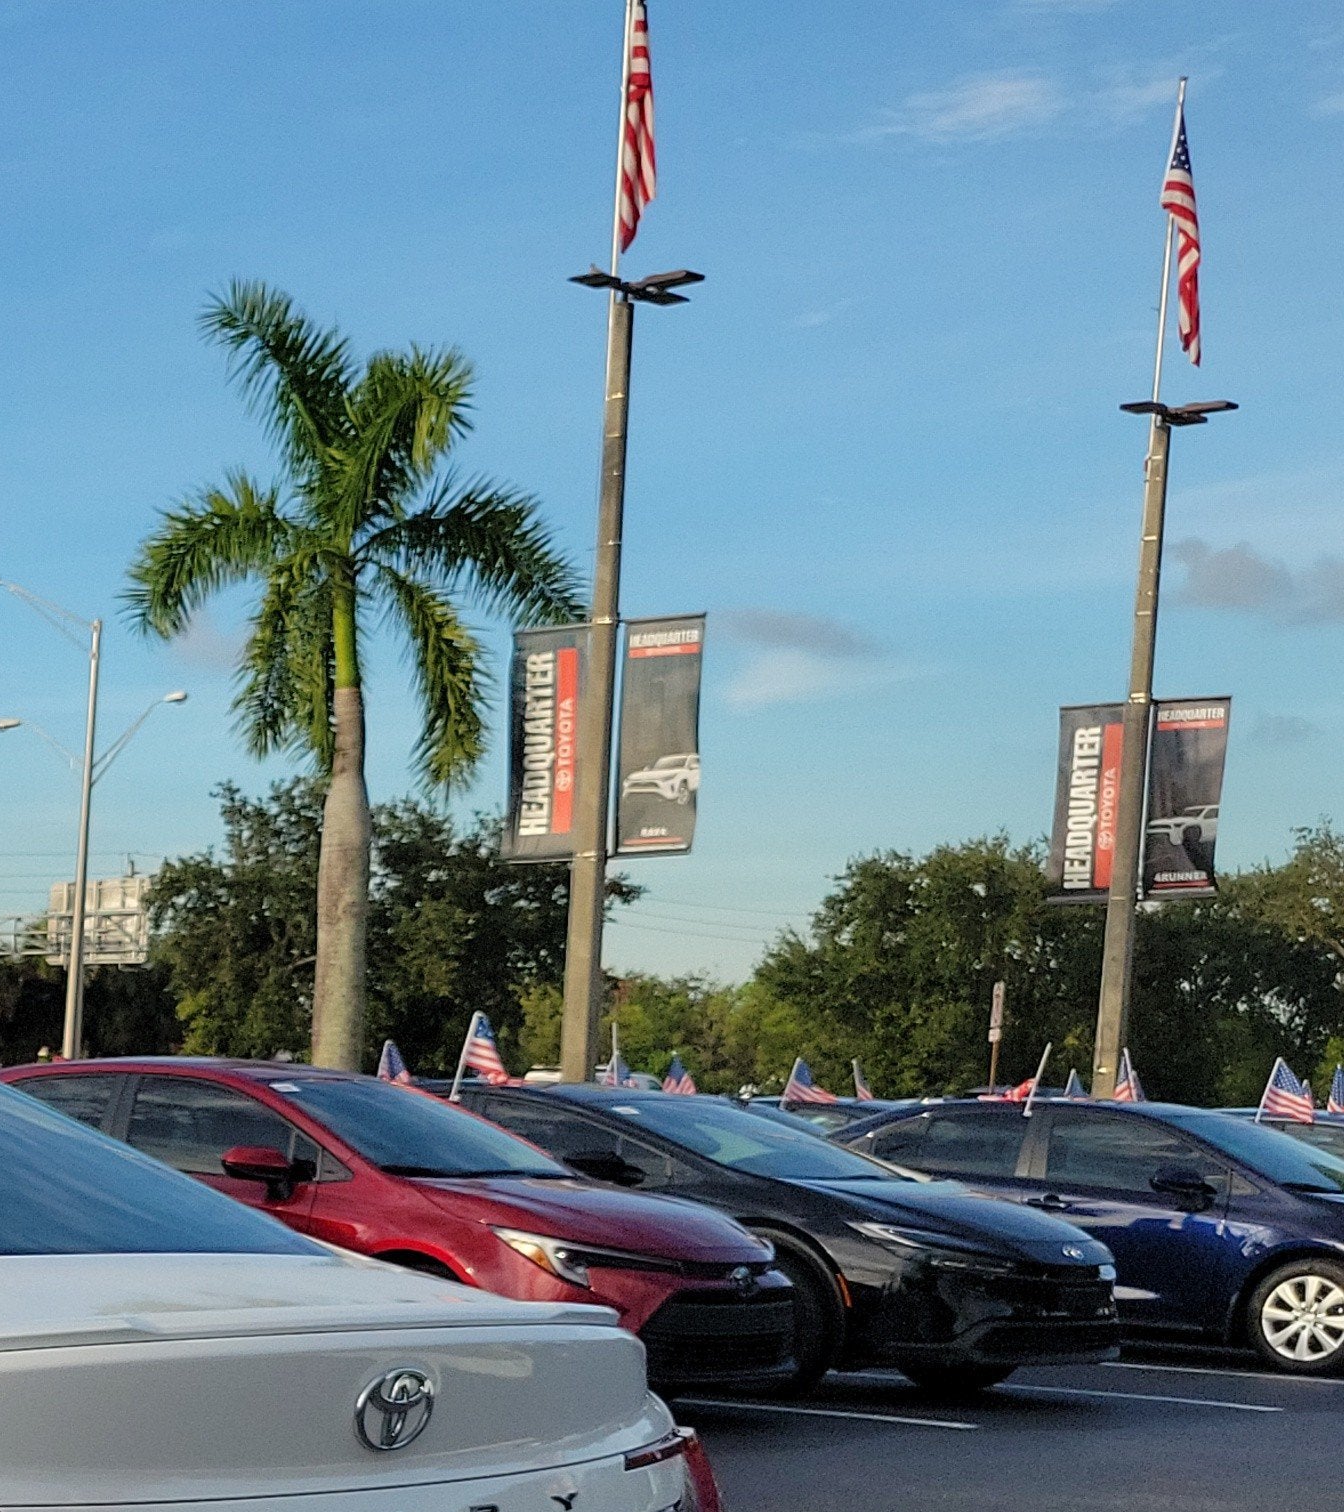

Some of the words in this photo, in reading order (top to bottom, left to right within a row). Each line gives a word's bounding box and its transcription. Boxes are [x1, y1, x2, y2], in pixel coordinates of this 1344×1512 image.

[519, 651, 555, 836] HEADQUARTER
[558, 697, 574, 767] TOYOTA
[1063, 725, 1101, 890] HEADQUARTER
[1100, 768, 1117, 828] TOYOTA
